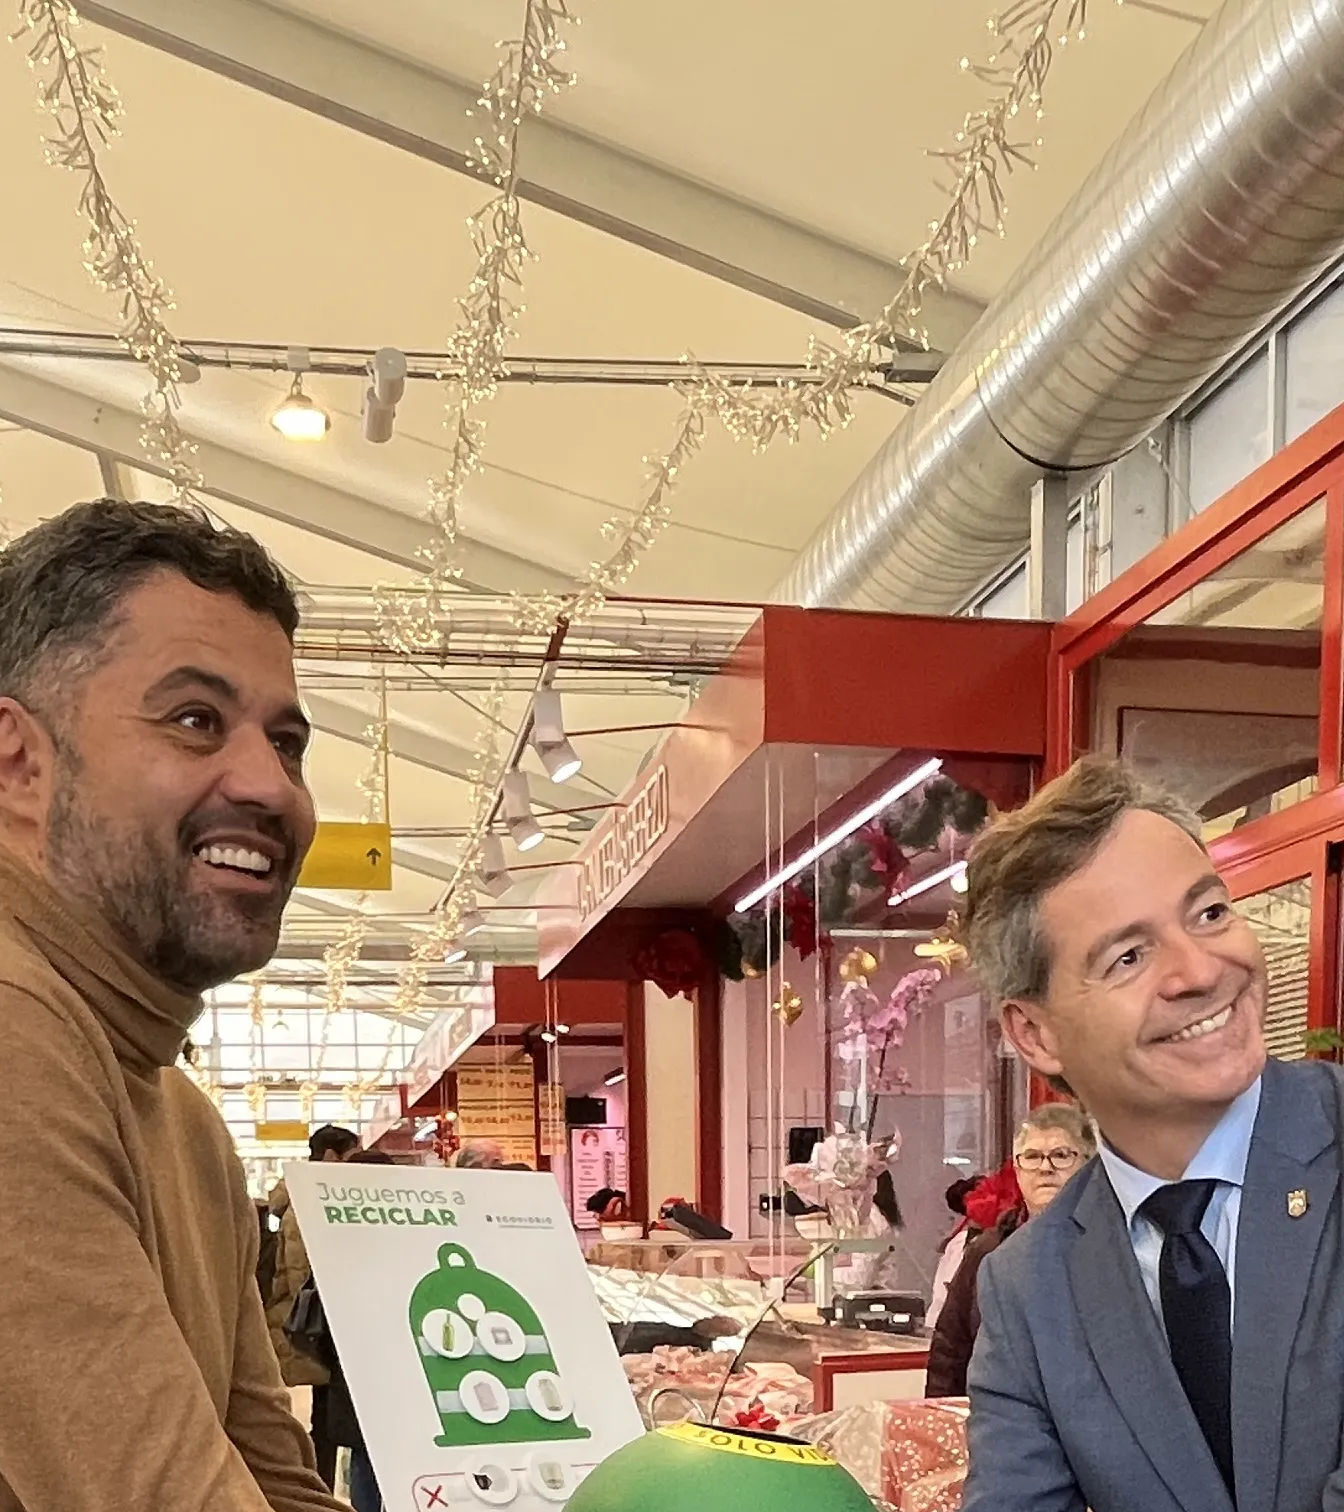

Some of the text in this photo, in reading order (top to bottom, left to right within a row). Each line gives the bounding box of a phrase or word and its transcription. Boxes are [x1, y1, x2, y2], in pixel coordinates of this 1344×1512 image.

[316, 1182, 466, 1206] Juguemos a
[324, 1205, 458, 1227] RECICLAR
